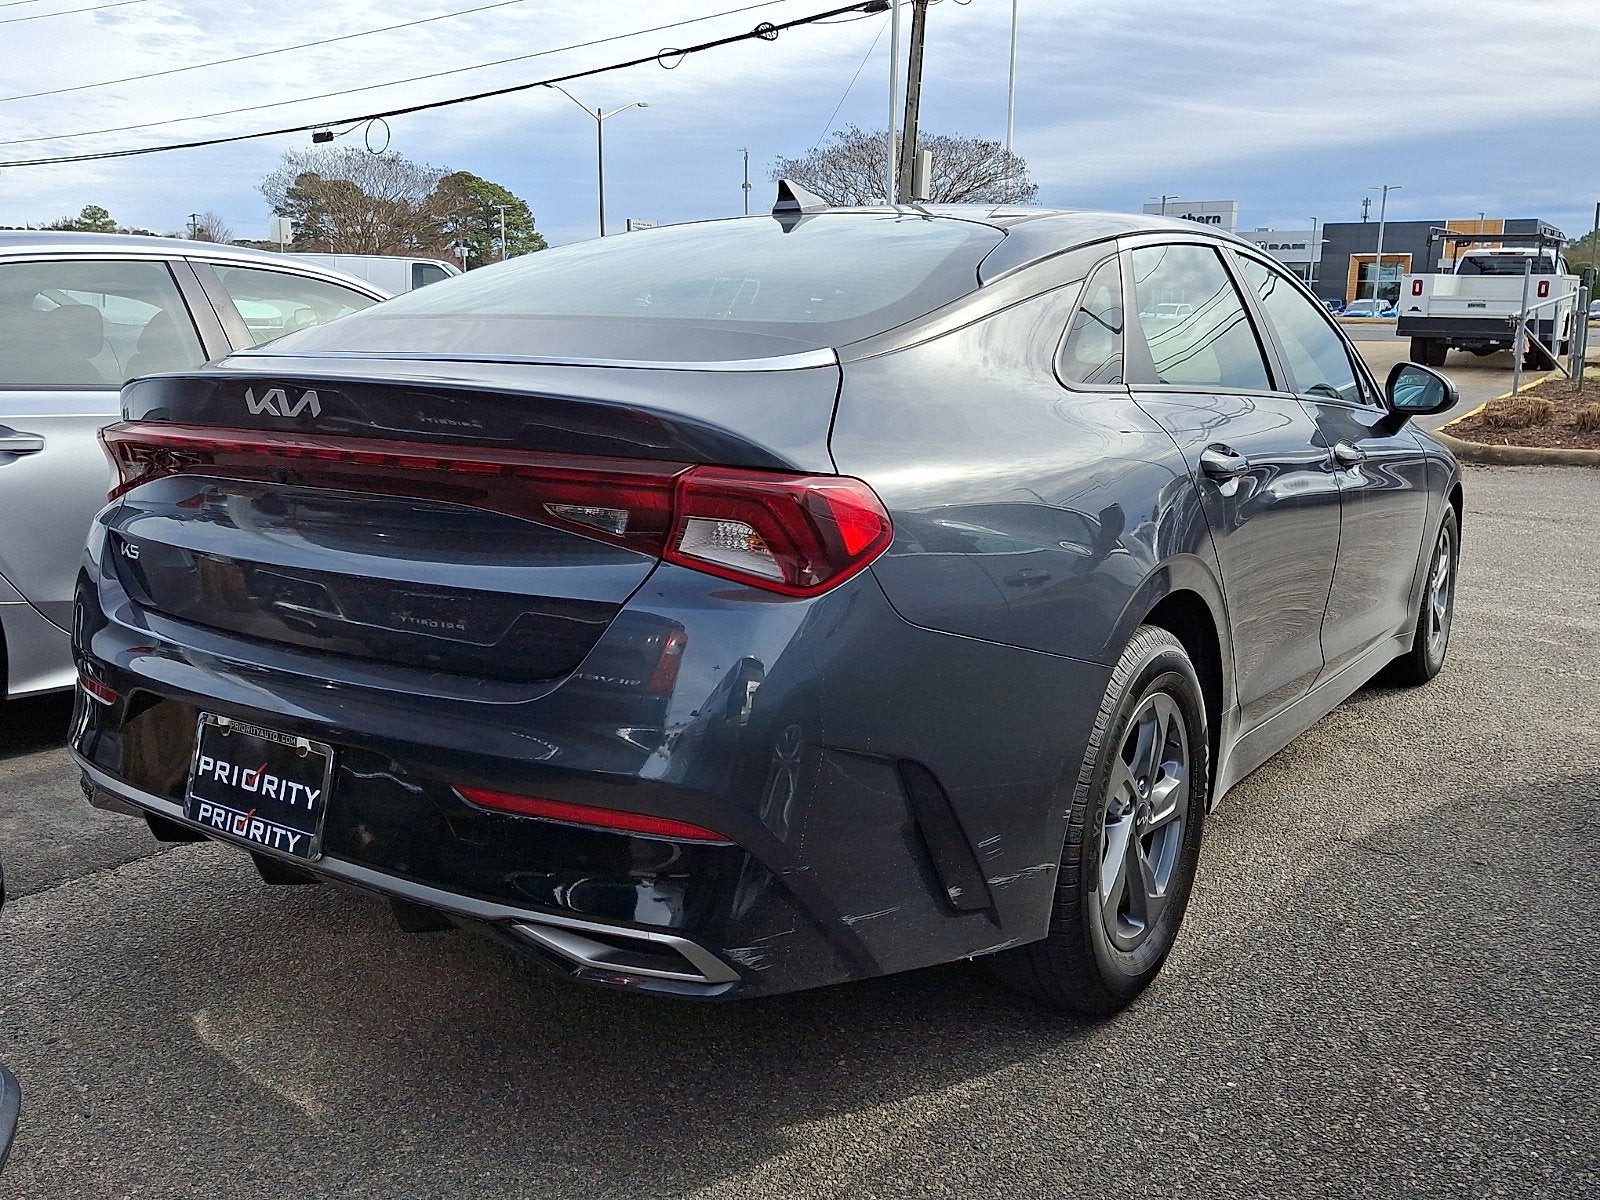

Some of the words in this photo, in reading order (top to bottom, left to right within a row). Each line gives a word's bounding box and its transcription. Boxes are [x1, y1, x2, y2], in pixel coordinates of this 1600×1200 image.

[245, 387, 321, 418] KIA
[120, 541, 140, 560] K5
[198, 755, 321, 810] PRIORITY
[198, 803, 302, 853] PRIORITY
